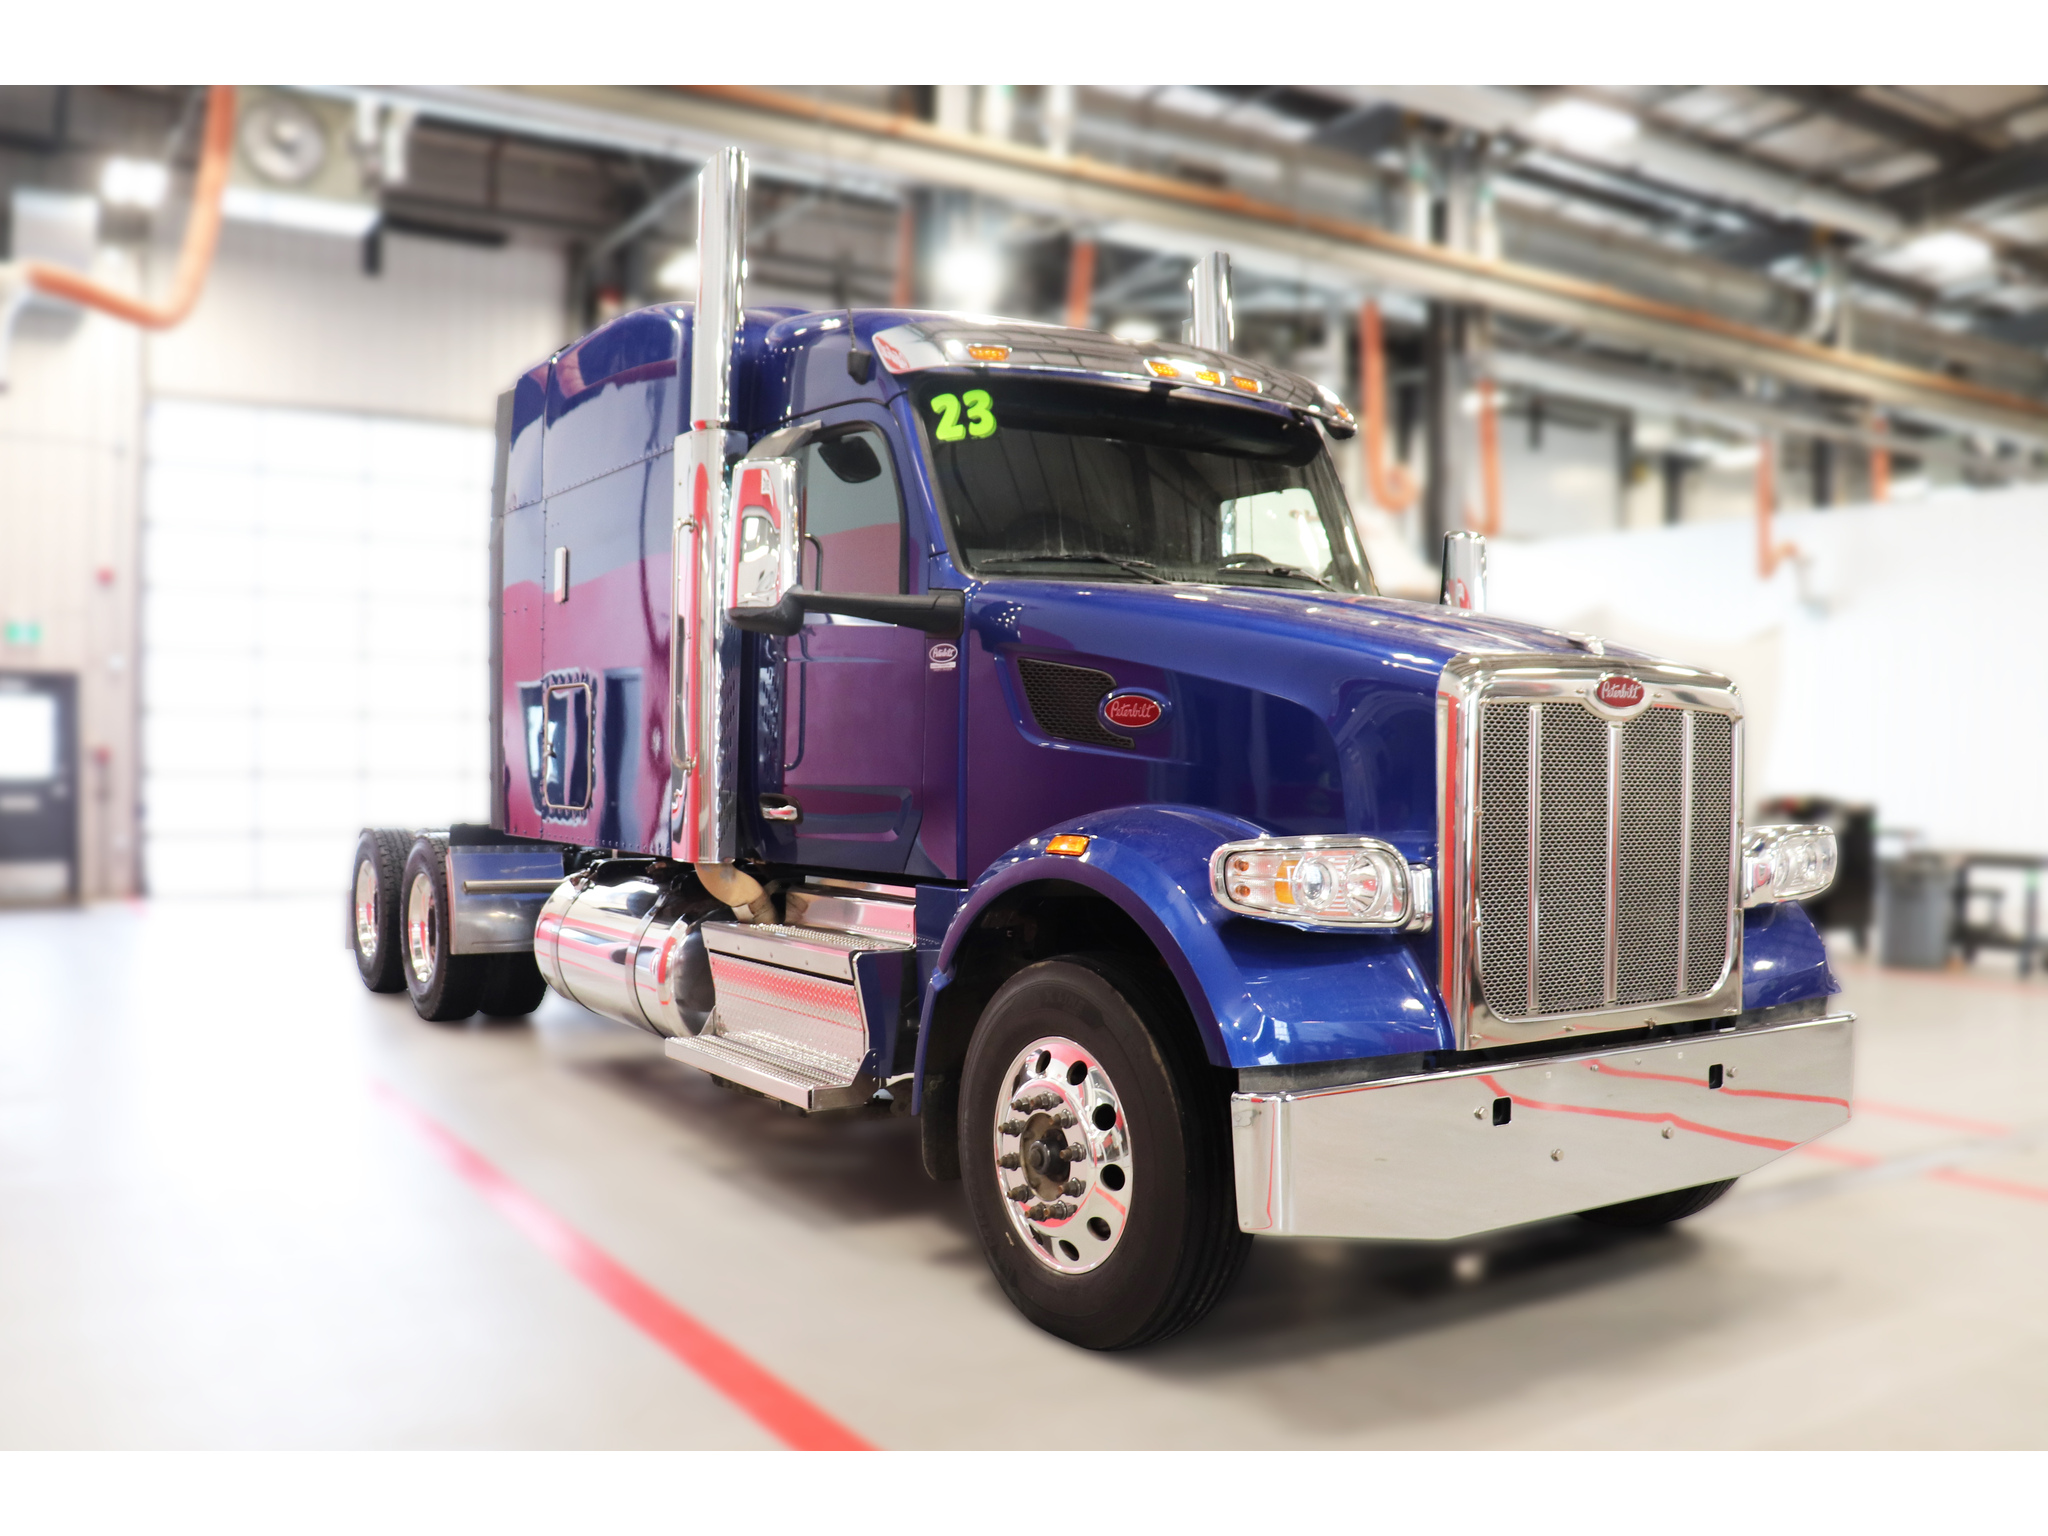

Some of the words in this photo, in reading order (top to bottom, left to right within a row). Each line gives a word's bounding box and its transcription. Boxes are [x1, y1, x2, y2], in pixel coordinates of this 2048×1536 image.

[931, 389, 997, 441] 23
[1602, 681, 1641, 699] Peterbilt
[1110, 701, 1155, 718] Peterbilt
